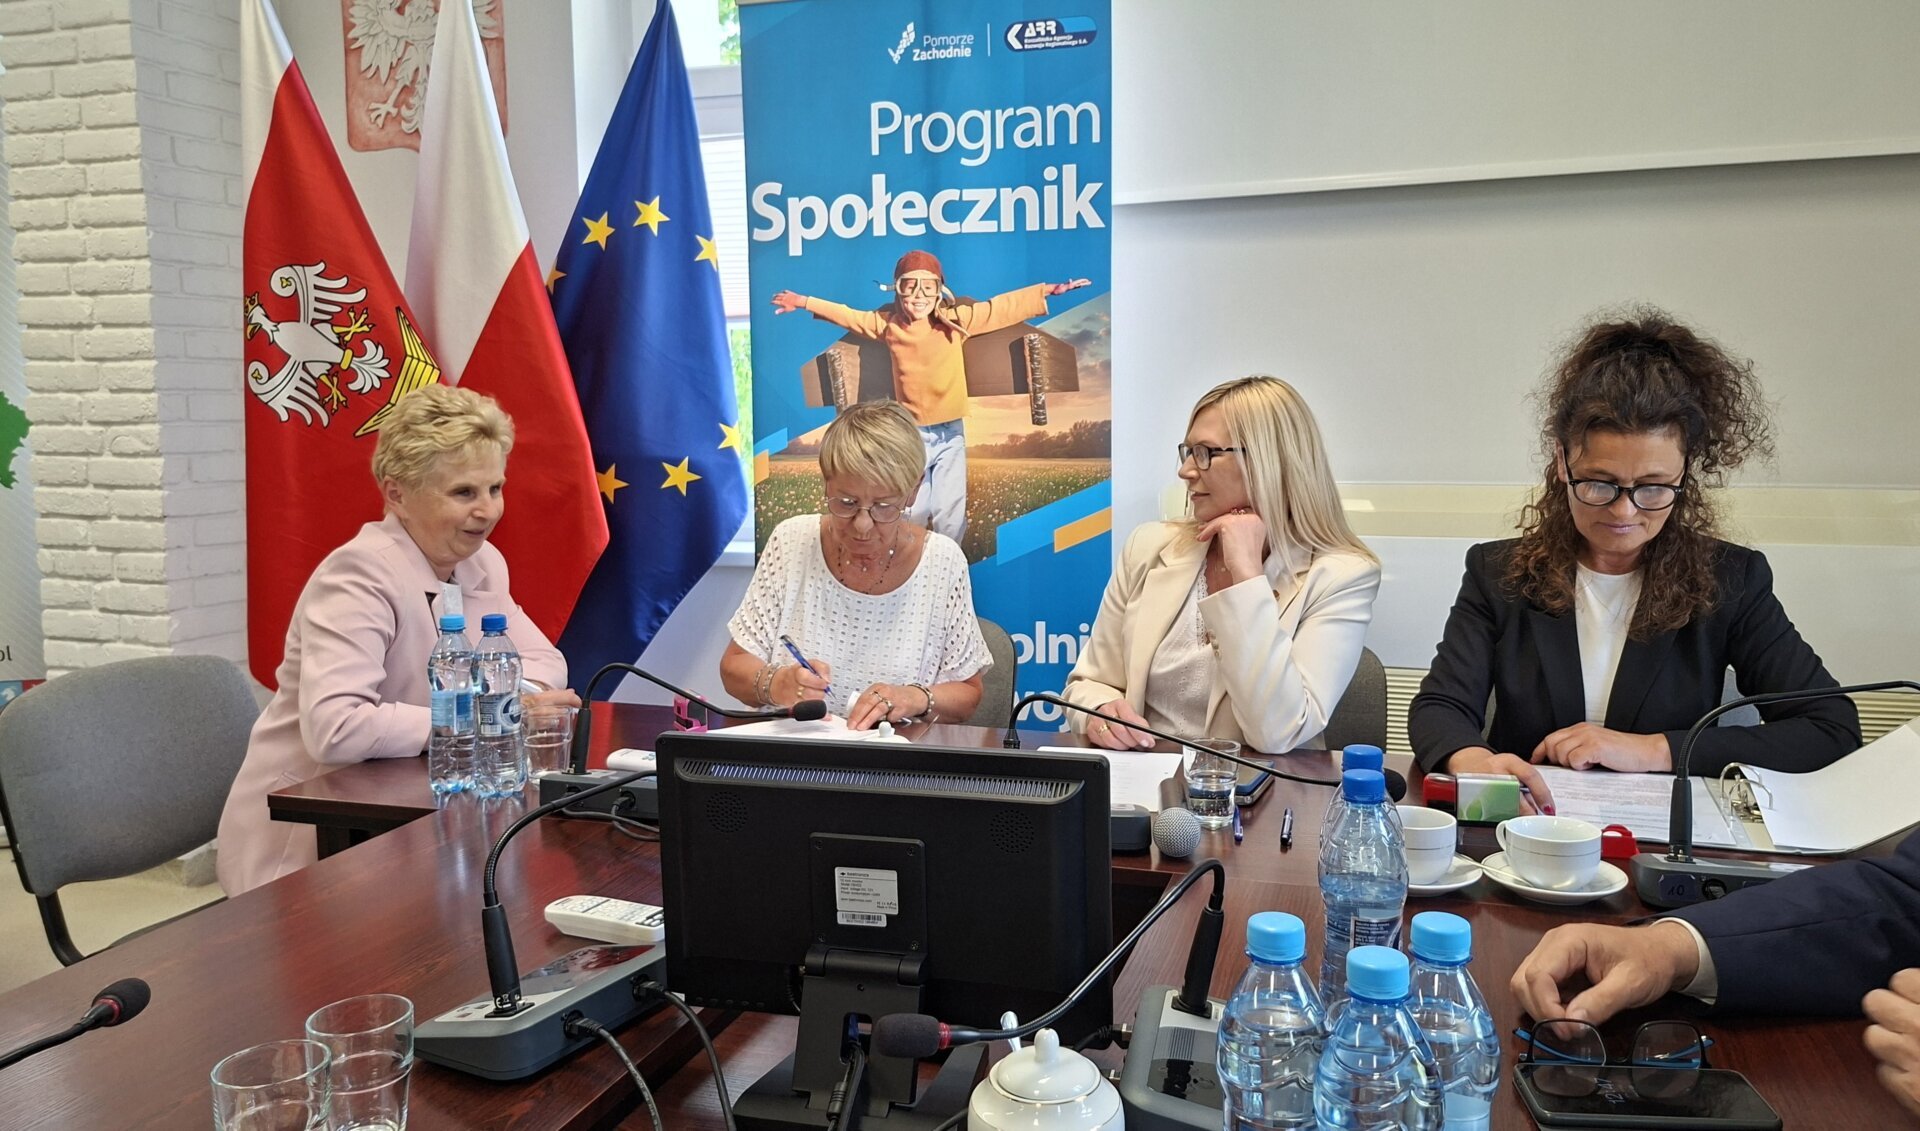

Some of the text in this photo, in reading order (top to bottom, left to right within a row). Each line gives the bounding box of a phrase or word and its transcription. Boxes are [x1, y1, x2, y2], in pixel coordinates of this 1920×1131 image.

[923, 34, 975, 47] Pomorze
[912, 47, 972, 62] Zachodnie
[870, 101, 1101, 166] Program
[752, 164, 1105, 256] Społecznik
[1670, 886, 1688, 898] 10
